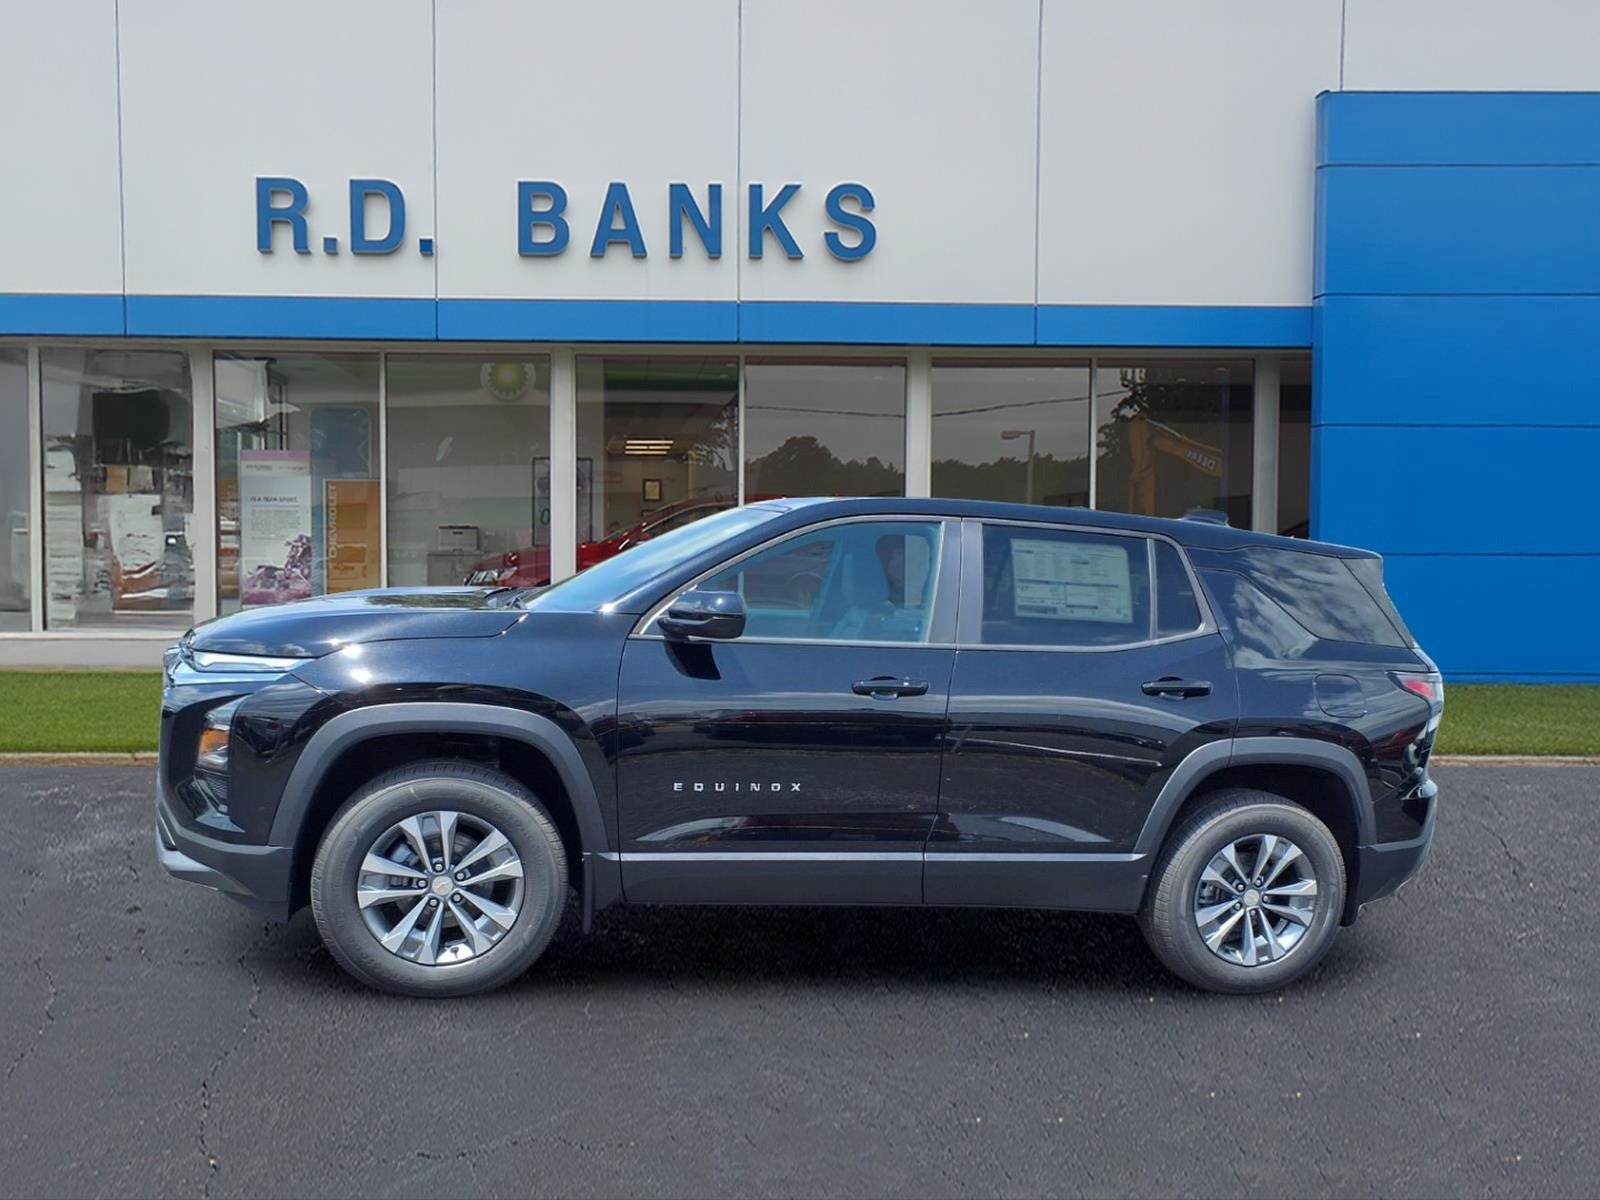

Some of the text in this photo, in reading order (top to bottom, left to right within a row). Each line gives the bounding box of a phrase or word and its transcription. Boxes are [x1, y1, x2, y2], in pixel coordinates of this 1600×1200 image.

[256, 177, 877, 262] R.D. BANKS
[673, 782, 801, 792] EQUINOX
